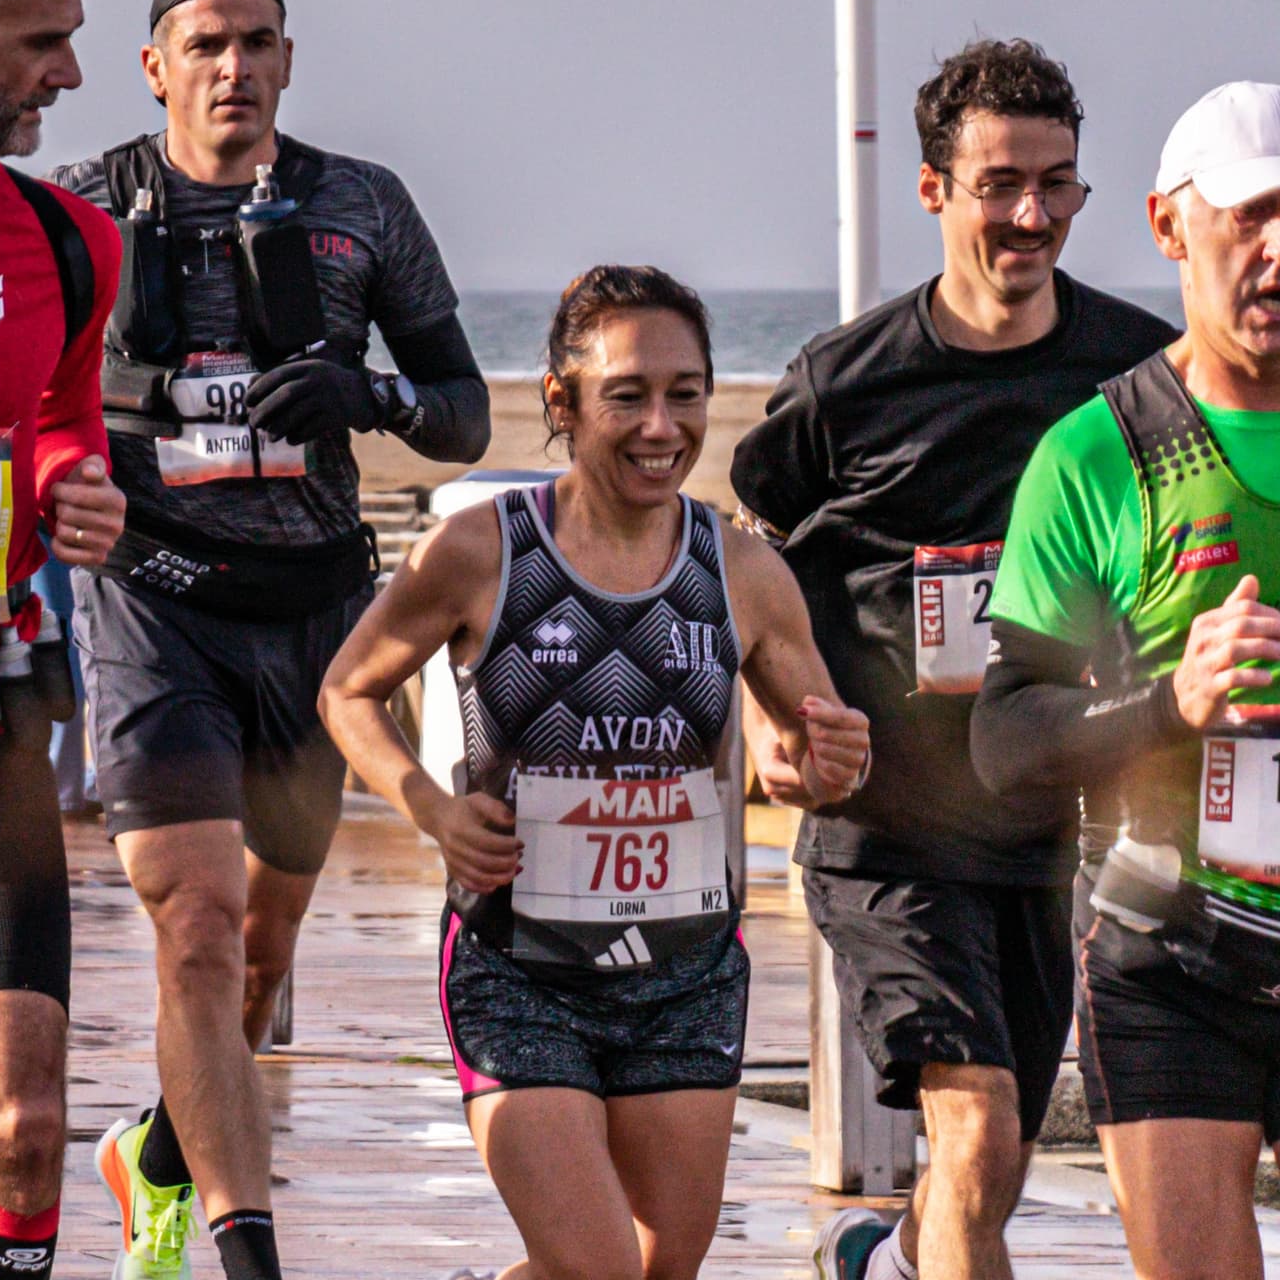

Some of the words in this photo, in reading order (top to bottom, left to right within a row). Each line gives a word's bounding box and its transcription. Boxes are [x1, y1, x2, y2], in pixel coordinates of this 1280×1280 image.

[206, 434, 267, 455] ANTHOY
[156, 550, 210, 574] COMP
[129, 566, 186, 594] PORT
[923, 583, 942, 633] CLIF
[532, 649, 578, 663] errea
[664, 658, 675, 668] 01
[676, 658, 688, 669] 60
[690, 659, 700, 670] 72
[578, 716, 686, 751] AVON
[1209, 746, 1233, 804] CLIF
[589, 783, 688, 819] MAIF
[1208, 805, 1230, 815] BAR
[586, 831, 670, 892] 763
[610, 901, 647, 916] LORNA
[701, 890, 722, 911] M2
